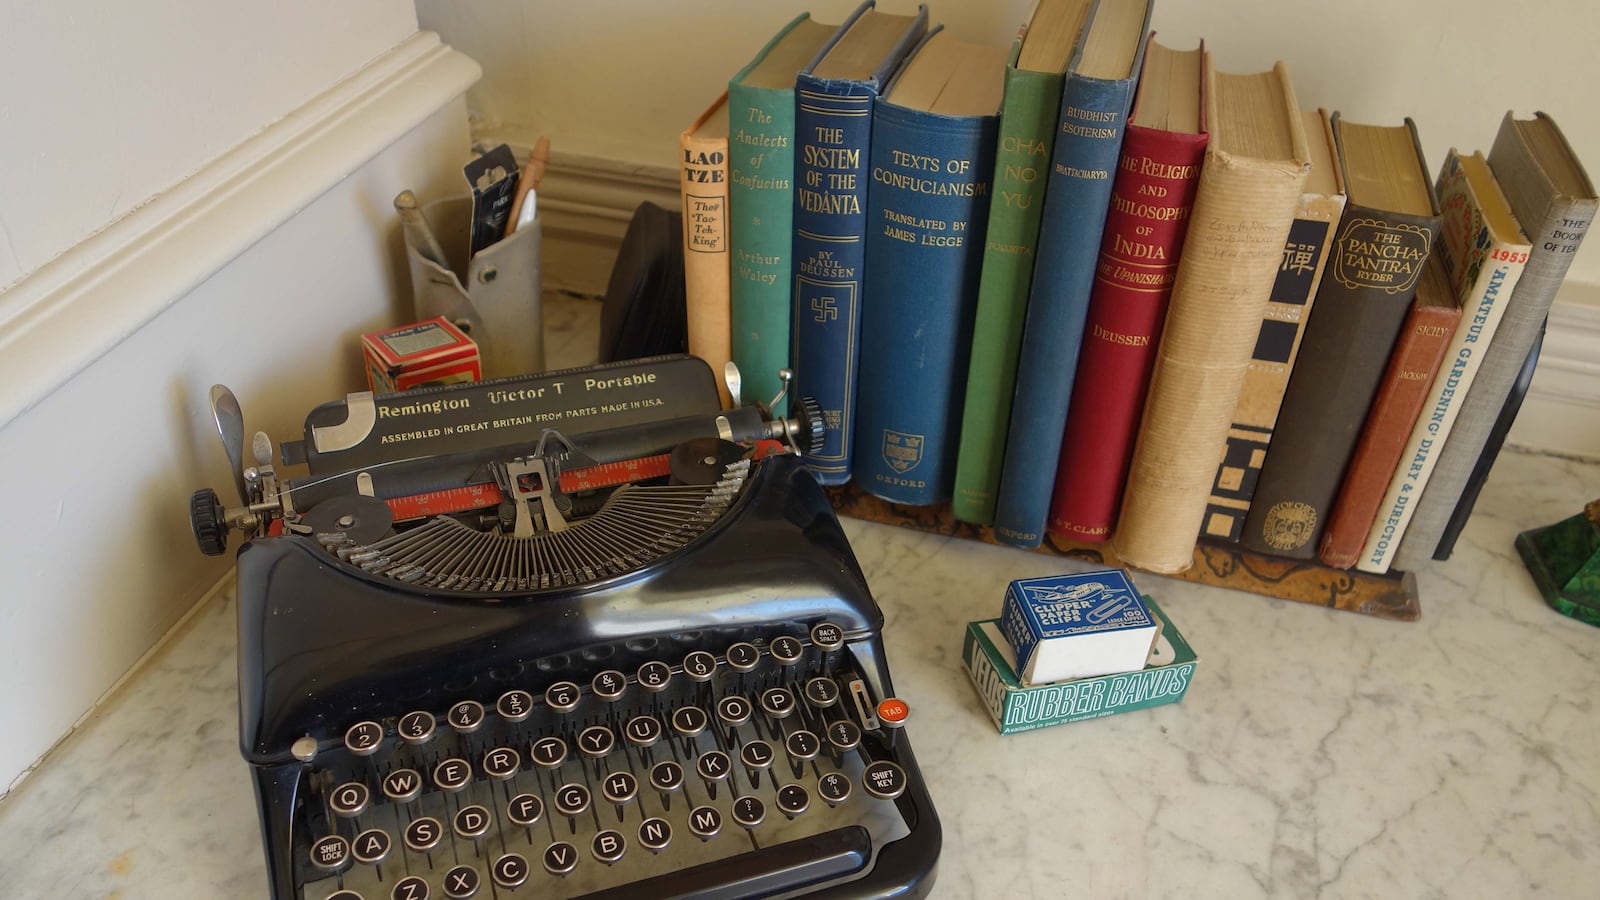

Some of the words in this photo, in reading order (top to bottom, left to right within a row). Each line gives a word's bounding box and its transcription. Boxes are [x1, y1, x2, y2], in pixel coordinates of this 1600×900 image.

[748, 108, 772, 123] The
[1067, 106, 1117, 122] BUDDHIST
[735, 128, 788, 147] Analects
[816, 127, 843, 145] THE
[1063, 122, 1117, 138] ESOTERISM
[1003, 136, 1047, 157] CHA
[684, 149, 724, 165] LAO
[751, 153, 763, 169] of
[804, 145, 860, 169] SYSTEM
[893, 150, 940, 173] TEXTS
[946, 160, 970, 174] OF
[685, 167, 724, 183] TZE
[732, 170, 790, 190] Confucius
[806, 171, 822, 187] OF
[829, 173, 857, 190] THE
[1004, 164, 1037, 182] NO
[873, 167, 987, 197] CONFUCIANISM
[1138, 184, 1167, 198] AND
[800, 188, 861, 215] VEDÂNTA
[1002, 191, 1033, 208] YU
[884, 209, 946, 231] TRANSLATED
[953, 221, 967, 232] BY
[1562, 219, 1585, 228] THE
[884, 225, 916, 243] JAMES
[921, 236, 964, 247] LEGGE
[1136, 226, 1153, 236] OF
[1374, 232, 1402, 244] THE
[1553, 230, 1584, 241] BOOK
[1114, 234, 1166, 259] INDIA
[1349, 238, 1423, 260] PANCHA-
[1544, 242, 1559, 252] OF
[738, 249, 780, 264] Arthur
[809, 257, 842, 269] PAUL
[818, 251, 833, 260] BY
[1281, 242, 1317, 276] 禪
[1490, 248, 1528, 265] 1953
[801, 262, 855, 278] DEUSSEN
[1345, 253, 1411, 274] TANTRA
[739, 266, 777, 286] Waley
[1356, 271, 1394, 283] RYDER
[1093, 324, 1150, 347] DEUSSEN
[1416, 325, 1448, 337] SICILY
[1400, 370, 1429, 381] JACKSON
[378, 398, 470, 419] Remington
[488, 387, 545, 404] Victor
[553, 383, 565, 395] T
[585, 372, 657, 392] Portable
[380, 428, 441, 445] ASSEMBLED
[444, 426, 454, 435] IN
[456, 421, 489, 433] GREAT
[492, 415, 532, 428] BRITAIN
[536, 411, 562, 423] FROM
[566, 406, 597, 418] PARTS
[601, 403, 629, 414] MADE
[1407, 439, 1433, 481] DIARY
[876, 474, 926, 487] OXFORD
[1401, 483, 1414, 493] &
[1000, 528, 1037, 540] OXFORD
[1371, 494, 1409, 565] DIRECTORY
[1031, 599, 1096, 613] "CLIPPER"
[1039, 609, 1081, 619] PAPER
[1042, 616, 1081, 625] CLIPS
[1123, 610, 1141, 618] 100
[696, 664, 706, 674] 9
[649, 673, 660, 684] 8
[558, 693, 570, 705] 6
[771, 694, 785, 708] P
[1006, 680, 1107, 725] RUBBER
[1106, 664, 1192, 708] BANDS
[512, 704, 523, 715] 5
[727, 703, 742, 716] O
[885, 707, 902, 717] TAB
[460, 714, 471, 725] 4
[1004, 724, 1036, 734] Available
[1069, 712, 1097, 722] standard
[412, 725, 423, 736] 3
[635, 723, 650, 736] U
[359, 734, 370, 746] 2
[589, 734, 604, 748] Y
[541, 742, 557, 758] T
[752, 747, 767, 760] L
[494, 754, 509, 769] R
[706, 758, 722, 771] K
[446, 766, 461, 781] E
[664, 768, 674, 783] J
[872, 770, 894, 780] SHIFT
[390, 776, 413, 792] W
[612, 779, 627, 793] H
[877, 779, 894, 788] KEY
[341, 789, 358, 806] Q
[564, 790, 582, 806] G
[520, 801, 533, 816] F
[466, 814, 481, 829] D
[696, 812, 715, 828] M
[416, 825, 432, 842] S
[647, 825, 663, 840] N
[320, 842, 342, 853] SHIFT
[366, 837, 382, 853] A
[602, 837, 618, 853] B
[322, 851, 343, 862] LOCK
[552, 848, 568, 865] V
[502, 862, 519, 878] C
[453, 872, 469, 890] X
[403, 884, 419, 900] Z
